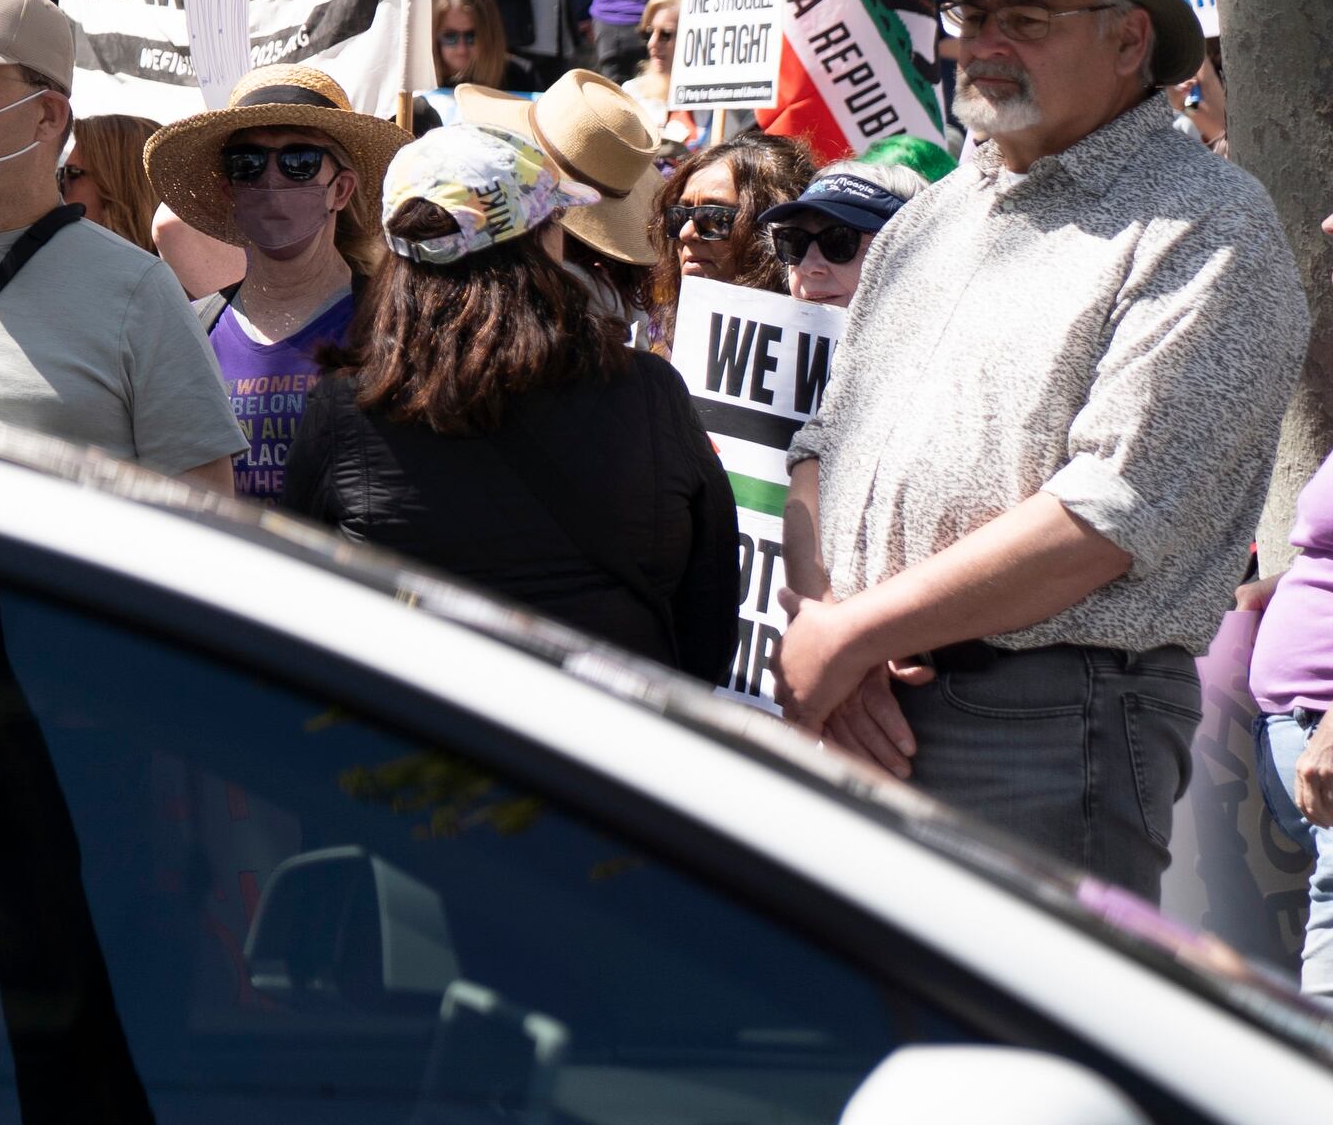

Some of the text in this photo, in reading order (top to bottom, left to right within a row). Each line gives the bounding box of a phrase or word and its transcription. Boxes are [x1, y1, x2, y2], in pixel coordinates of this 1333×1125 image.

[684, 22, 772, 68] ONE FIGHT
[474, 180, 514, 236] NIKE
[705, 311, 783, 406] WE
[236, 374, 321, 396] WOMEN
